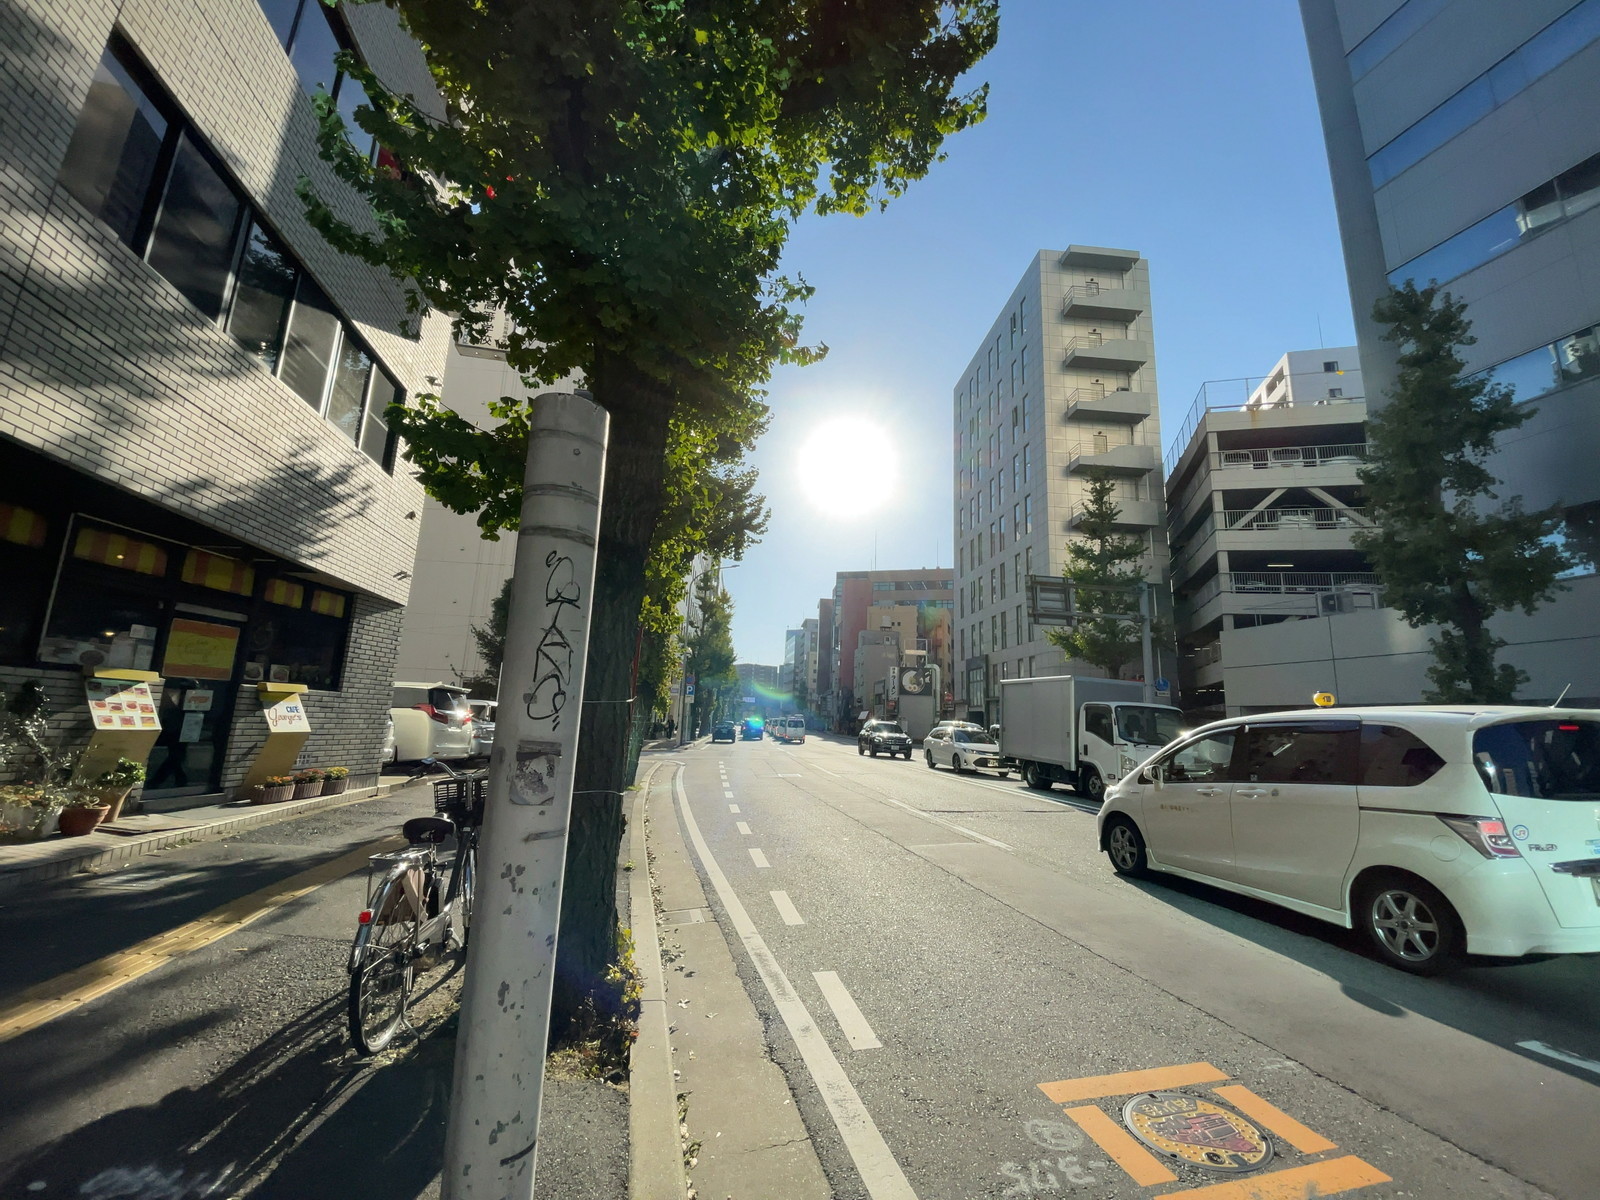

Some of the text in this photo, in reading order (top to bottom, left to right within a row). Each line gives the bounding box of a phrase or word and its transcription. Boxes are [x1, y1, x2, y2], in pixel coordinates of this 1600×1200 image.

[686, 685, 693, 695] P
[1138, 1098, 1197, 1116] 消火栓
